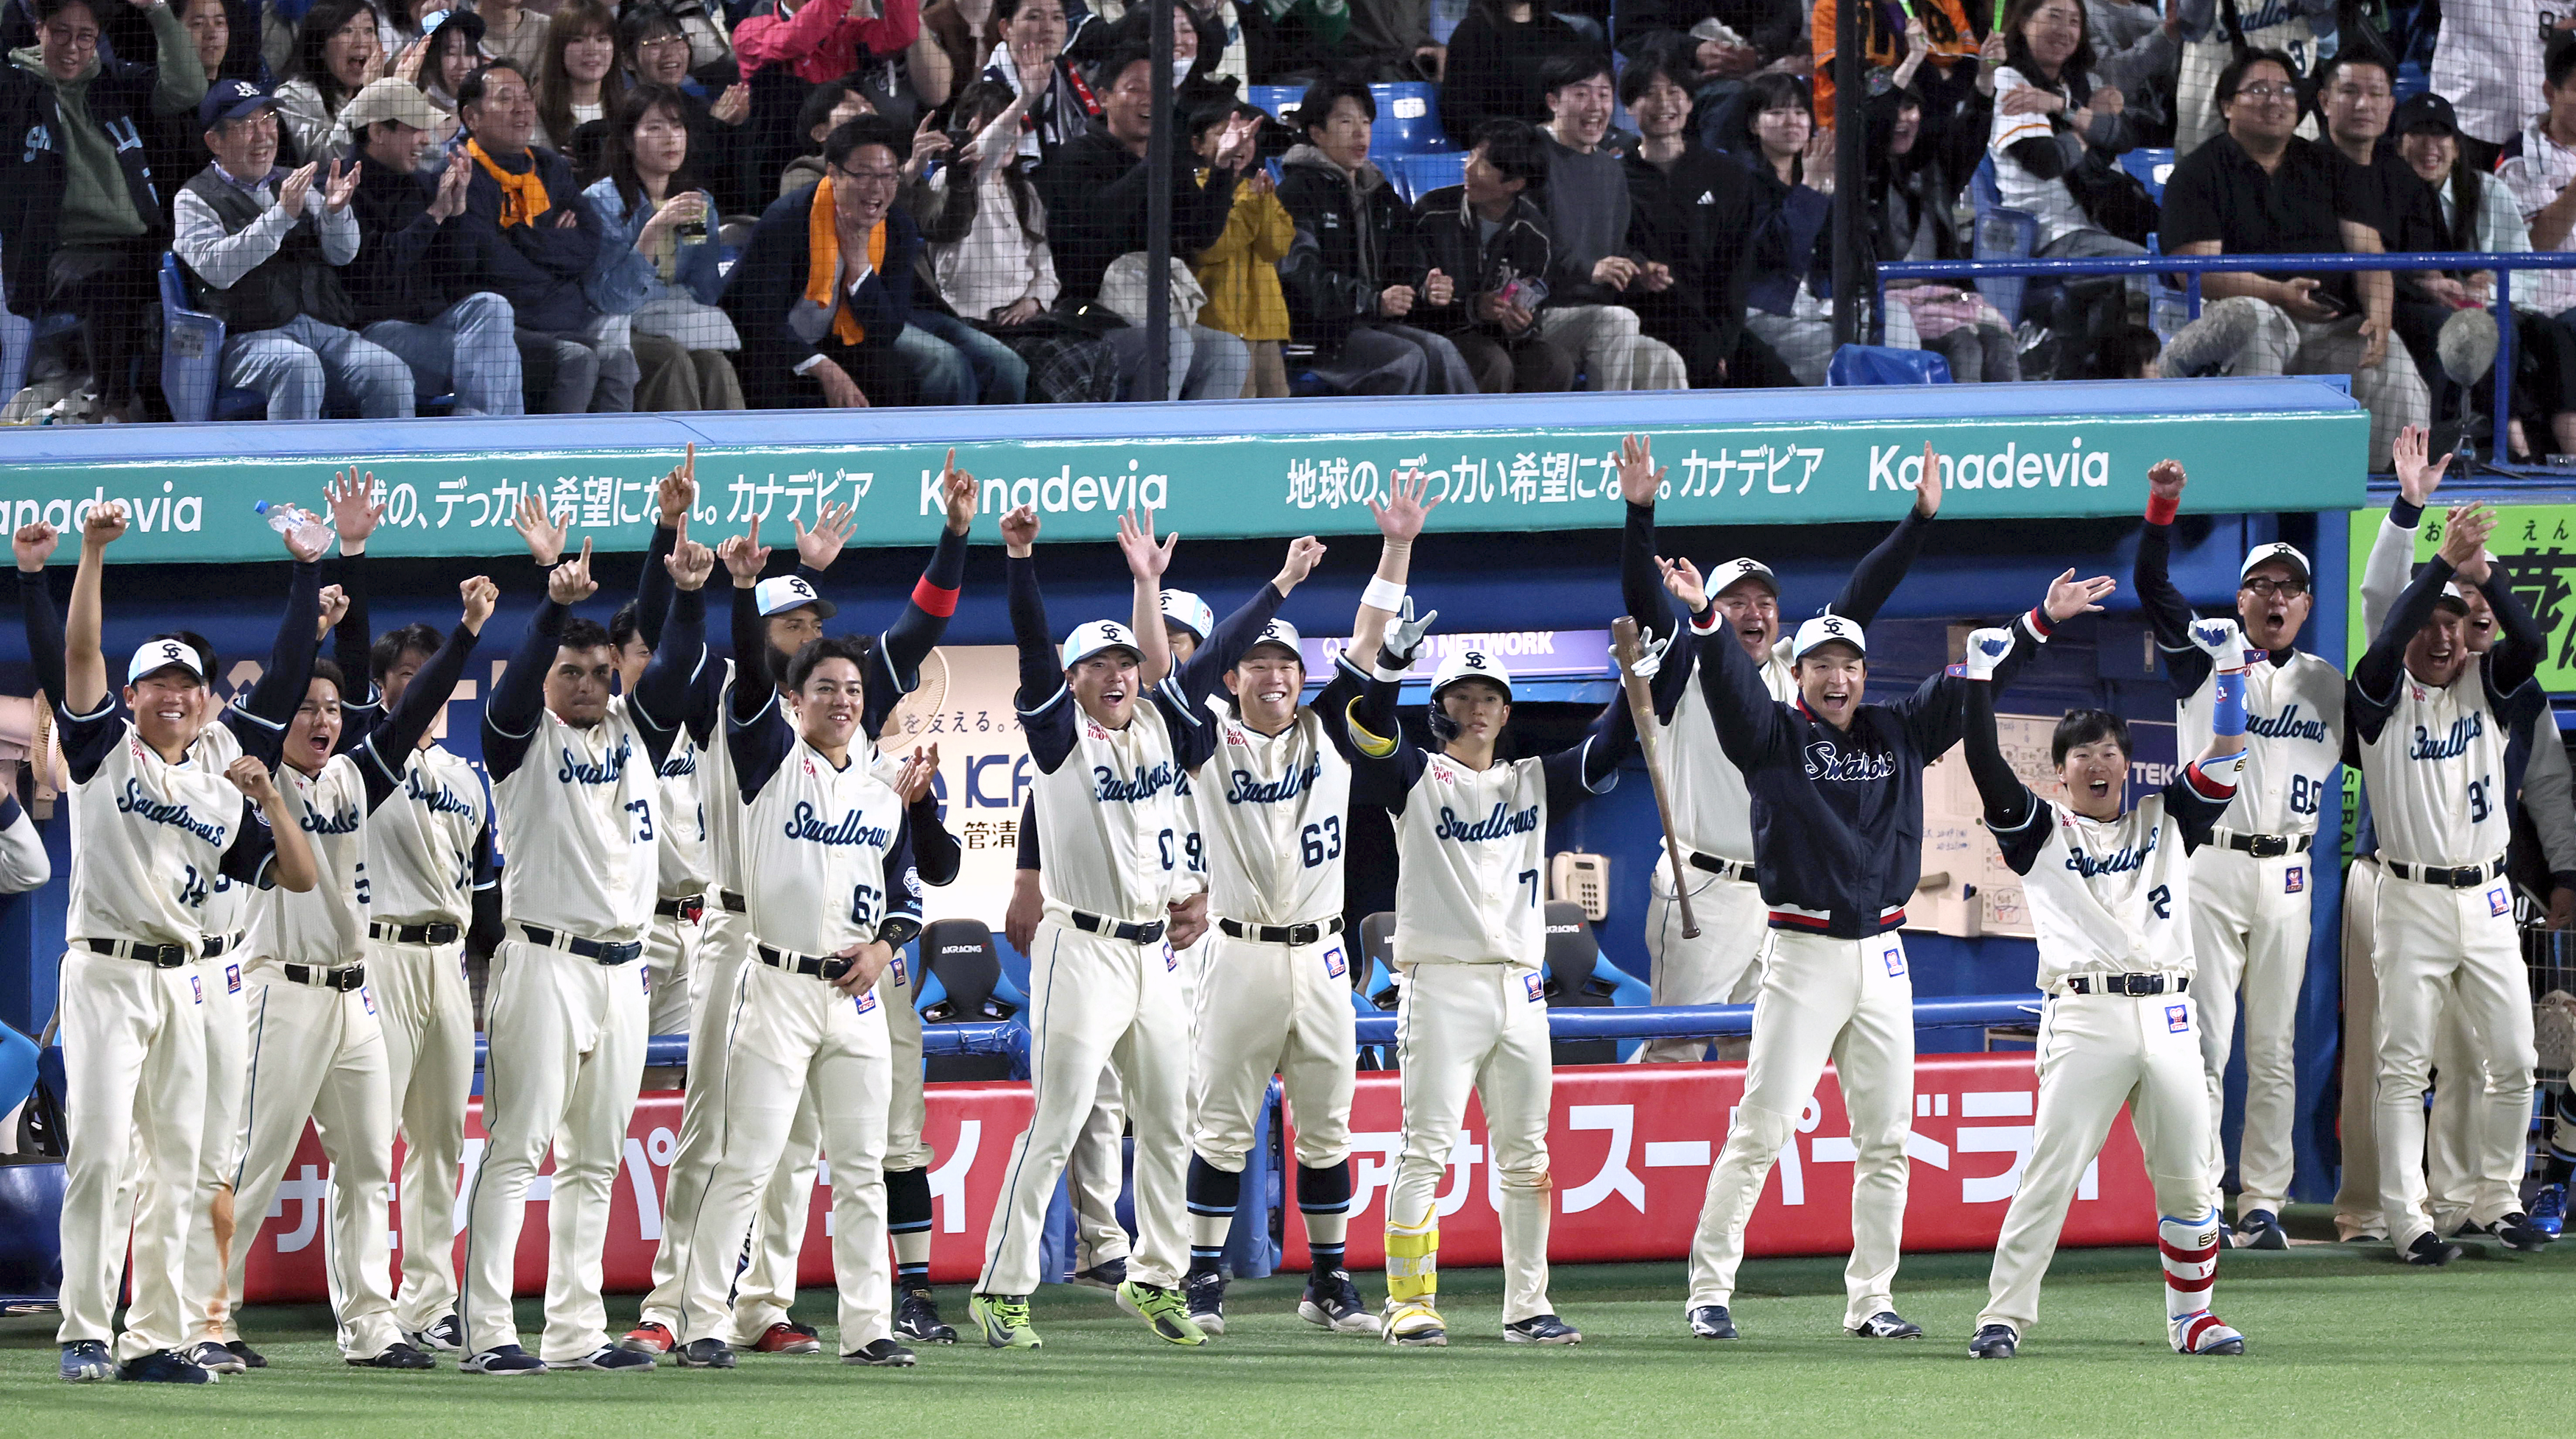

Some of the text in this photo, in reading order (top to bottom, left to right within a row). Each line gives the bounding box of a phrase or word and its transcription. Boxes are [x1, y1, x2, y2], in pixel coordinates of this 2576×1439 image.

[919, 459, 1168, 516] Knadevia
[1437, 632, 1554, 660] NETWORK
[2240, 704, 2327, 743] wallows
[2132, 761, 2179, 786] TEK
[1436, 802, 1539, 842] Swallows
[1185, 832, 1207, 873] 9
[1301, 815, 1340, 869] 63
[1518, 869, 1539, 910] 7
[2147, 884, 2171, 919] 2
[1546, 924, 1580, 934] KRACING
[941, 944, 983, 955] AKRACING
